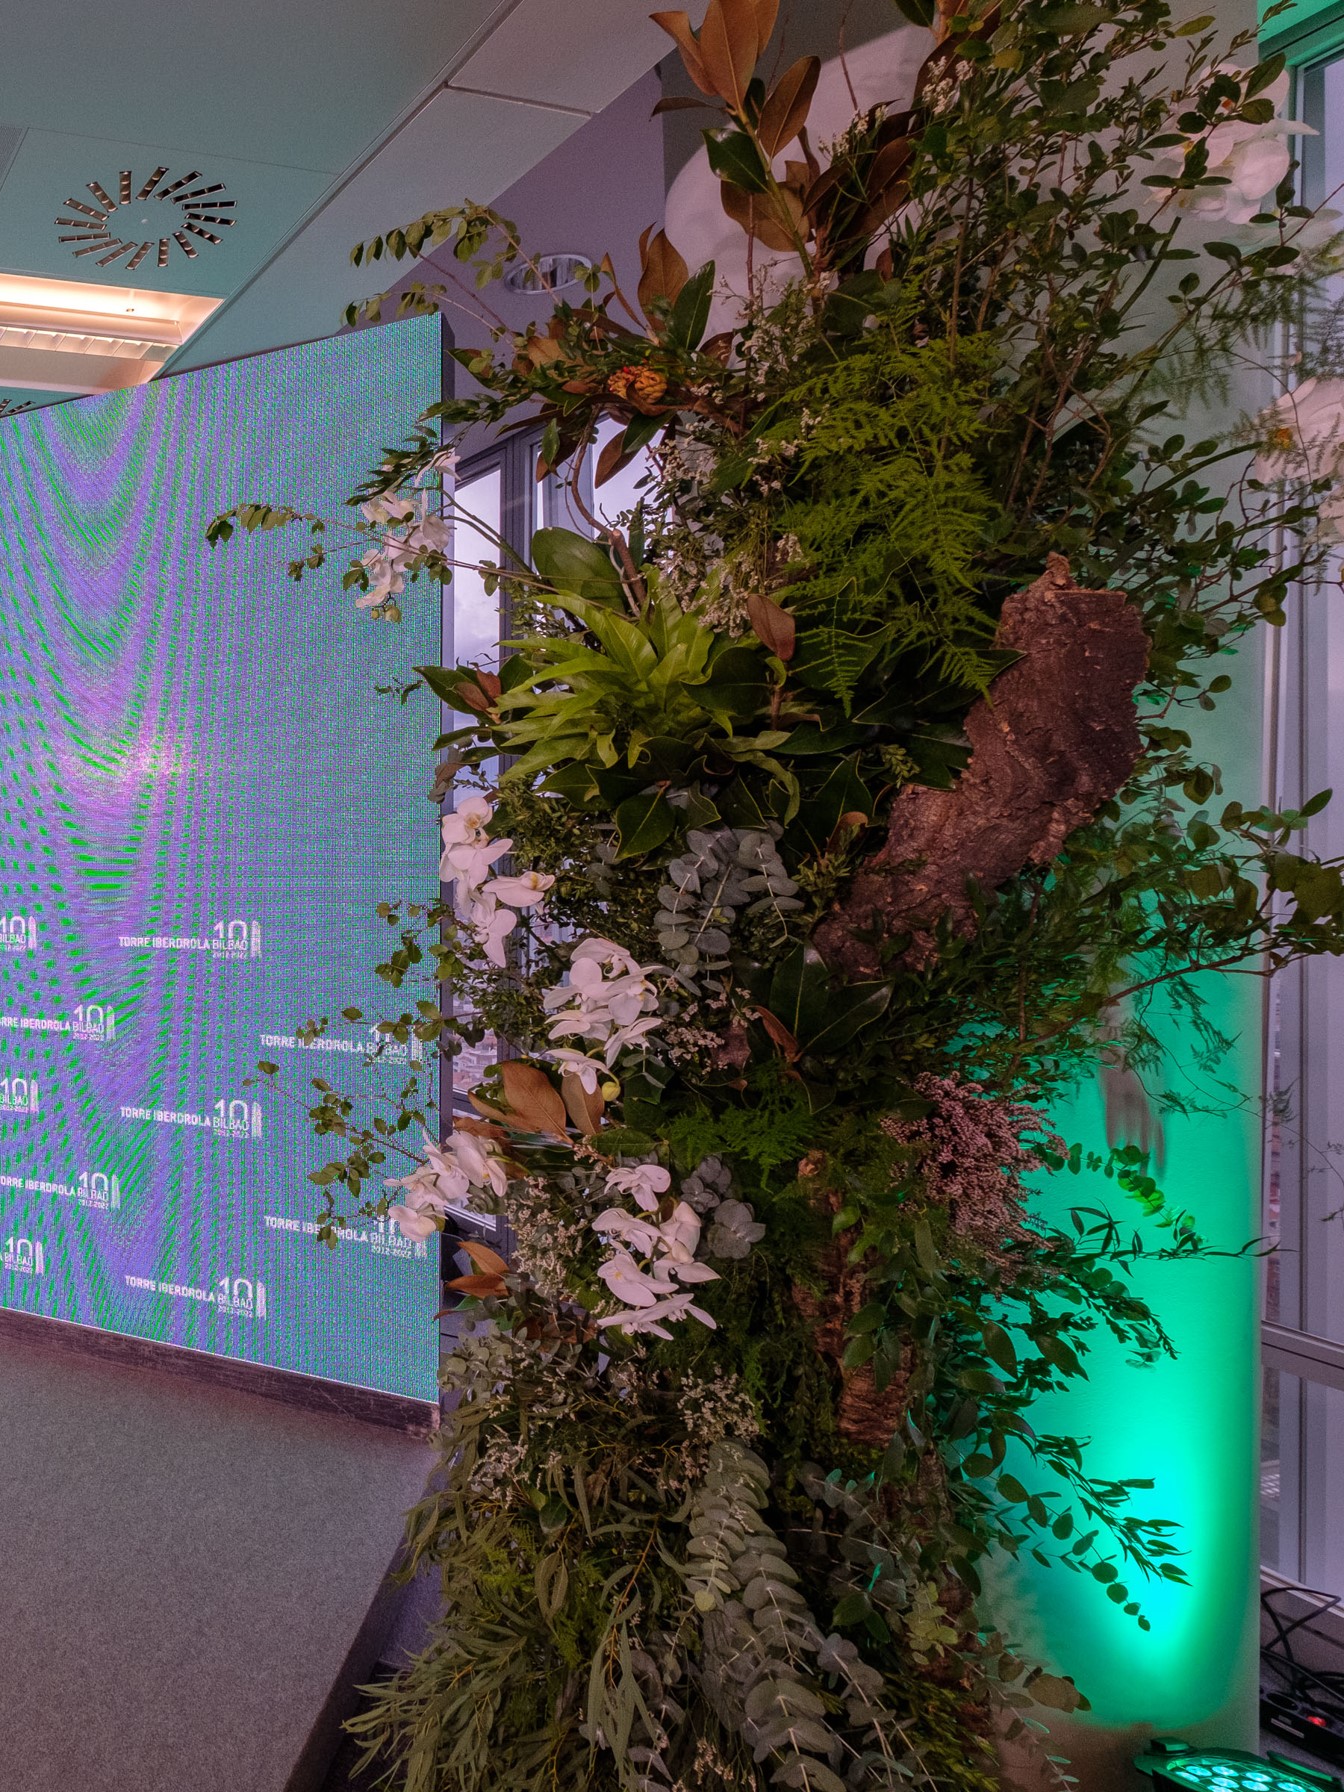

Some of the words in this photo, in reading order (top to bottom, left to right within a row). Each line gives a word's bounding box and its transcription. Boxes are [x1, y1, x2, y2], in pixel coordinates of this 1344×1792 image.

[214, 921, 248, 939] 10
[119, 937, 150, 947] TORRE
[153, 938, 210, 949] IBERDROLA
[74, 1005, 104, 1023] 10
[21, 1018, 71, 1031] IBERDROLA
[260, 1036, 296, 1048] TORRE
[0, 1078, 28, 1096] 10
[120, 1107, 151, 1120] TORRE
[154, 1111, 211, 1127] IBERDROLA
[214, 1099, 248, 1120] 10
[26, 1180, 76, 1196] IBERDROLA
[79, 1172, 109, 1191] 10
[265, 1217, 300, 1232] TORRE
[5, 1237, 33, 1257] 10
[125, 1276, 156, 1291] TORRE
[159, 1282, 216, 1303] IBERDROLA
[219, 1276, 253, 1299] 10
